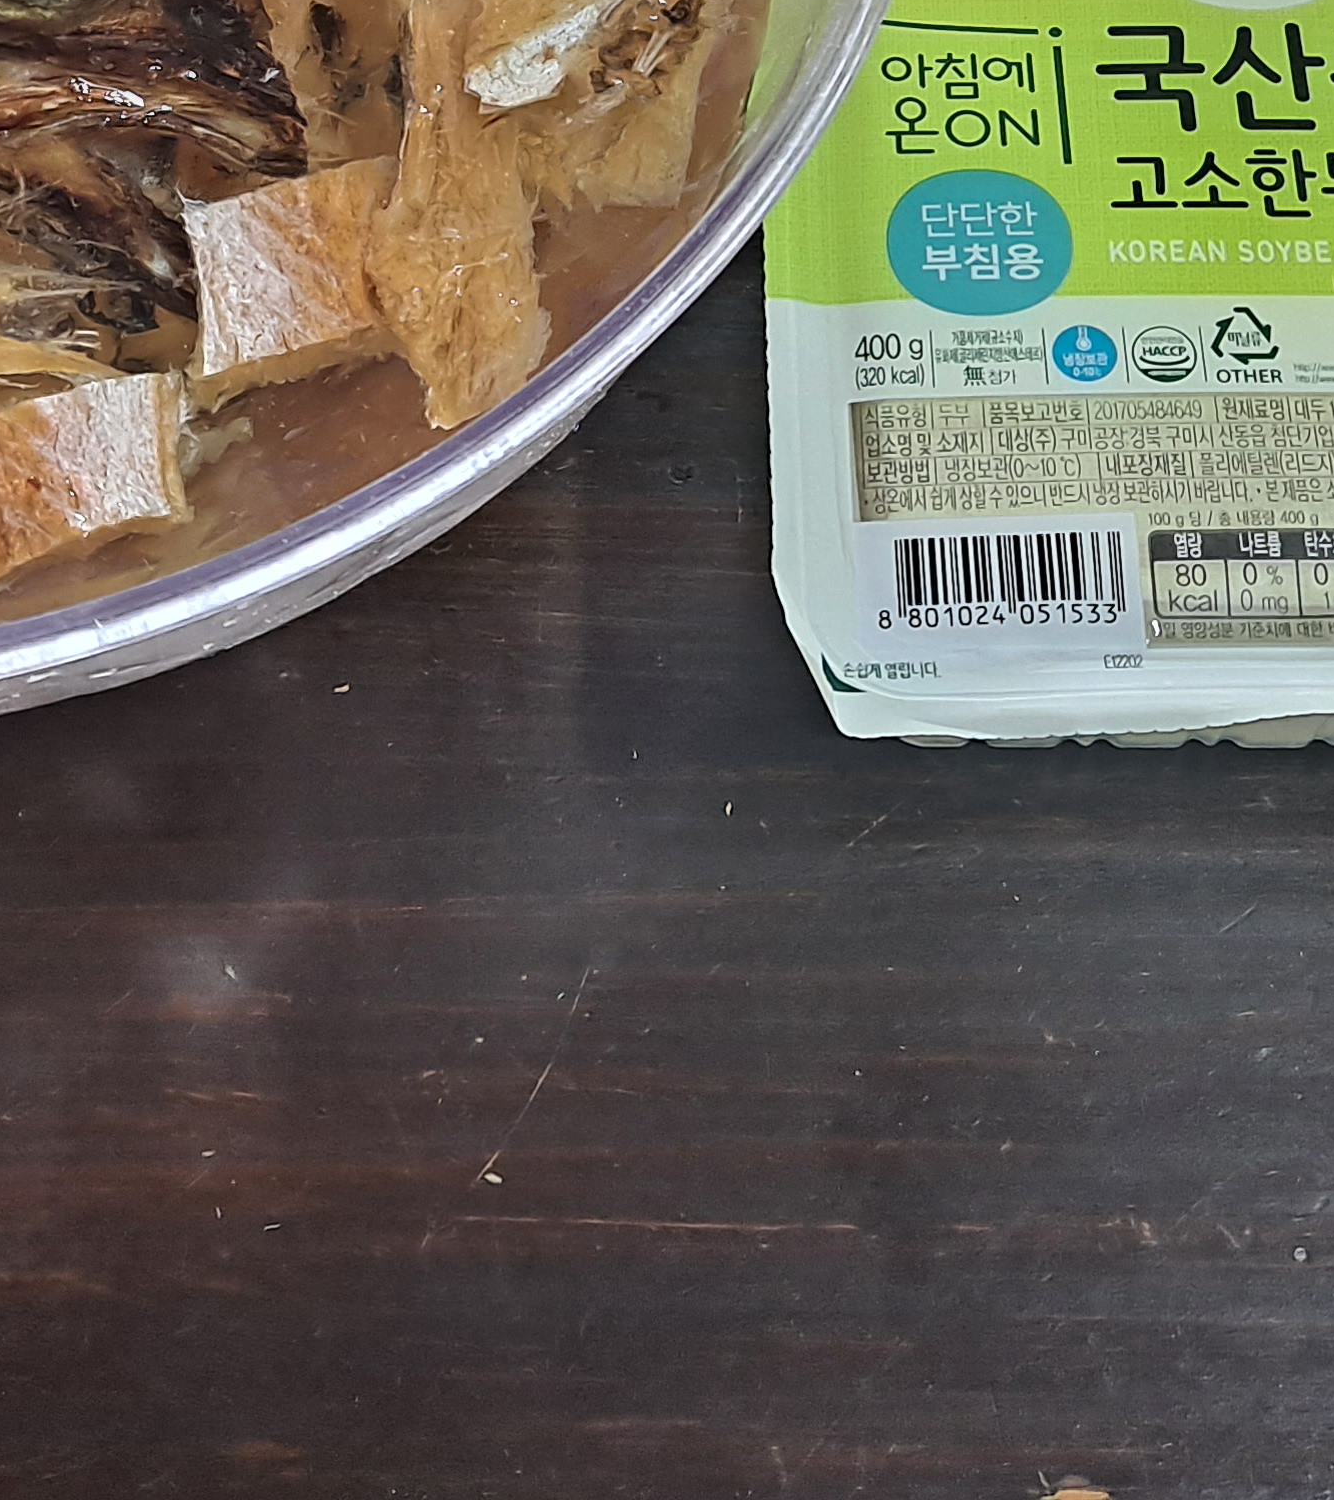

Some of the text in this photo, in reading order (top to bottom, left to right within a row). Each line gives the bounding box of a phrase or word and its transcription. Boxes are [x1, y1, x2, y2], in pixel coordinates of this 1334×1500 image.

[880, 51, 1037, 100] 아침에
[885, 96, 1041, 155] 온ON
[921, 200, 1039, 239] 단단한
[921, 241, 1045, 283] 부침용
[1108, 239, 1227, 264] KOREAN
[854, 332, 924, 361] 400 g
[1141, 345, 1187, 358] HACCP
[855, 365, 925, 390] (320 kcal)
[963, 364, 1017, 386] 無 첨가
[1216, 368, 1283, 384] OTHER
[865, 403, 927, 429] 식품유형
[939, 404, 970, 426] 두부
[990, 400, 1085, 425] 품목보고번호
[1094, 398, 1203, 421] 201705484649
[1222, 397, 1286, 421] 원재료명
[1295, 397, 1327, 421] 대두
[867, 433, 912, 458] 업소명
[937, 429, 984, 454] 소재지
[999, 428, 1057, 453] 대상(주)
[1166, 424, 1214, 449] 구미시
[1219, 423, 1266, 448] 산동읍
[868, 459, 930, 484] 보관방법
[1106, 453, 1187, 477] 내포장재질
[874, 487, 927, 515] 상온에서
[931, 487, 957, 512] 쉽게
[1049, 483, 1091, 507] 반드시
[1093, 481, 1121, 506] 냉장
[1123, 480, 1192, 504] 보관하시기
[1148, 510, 1306, 526] 100 400
[1174, 532, 1203, 559] 열량
[1238, 531, 1282, 558] 나트륨
[1175, 563, 1207, 587] 80
[878, 602, 1118, 629] 8 801024 051533
[1168, 589, 1219, 613] kcal
[1261, 594, 1290, 614] mg
